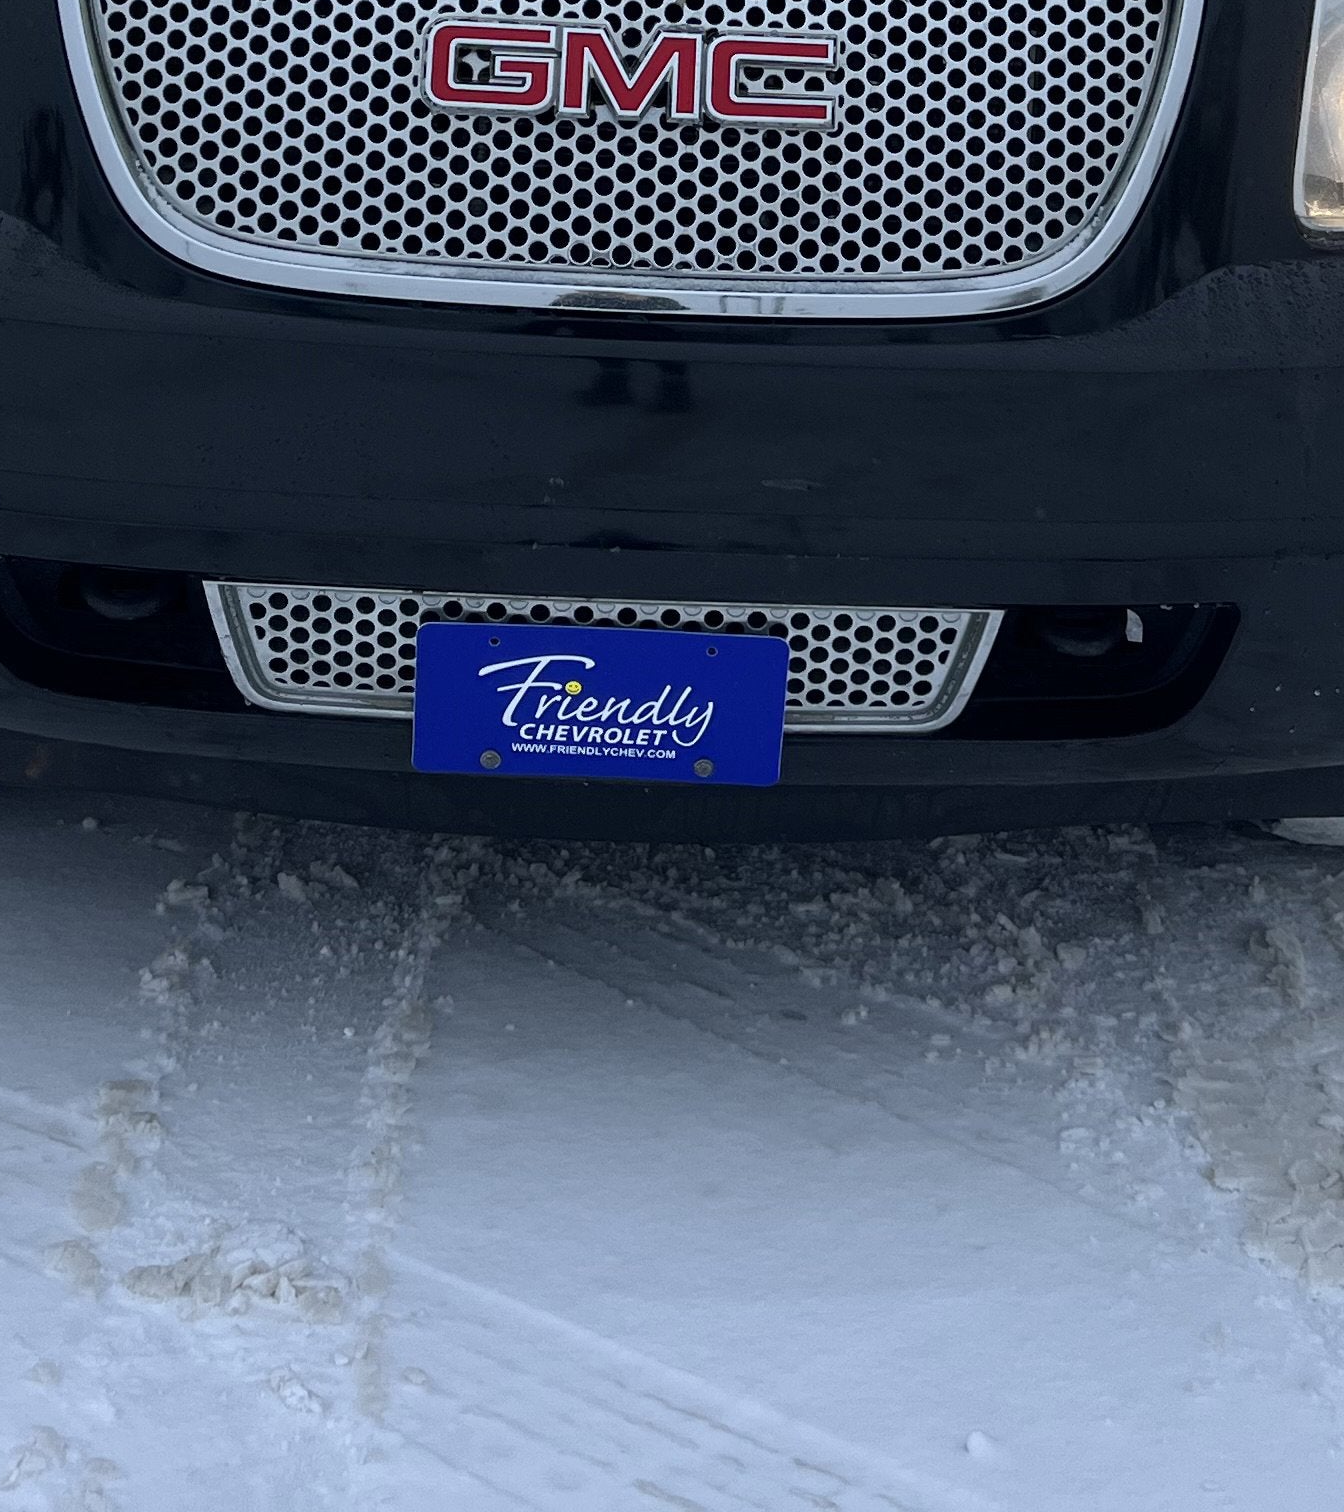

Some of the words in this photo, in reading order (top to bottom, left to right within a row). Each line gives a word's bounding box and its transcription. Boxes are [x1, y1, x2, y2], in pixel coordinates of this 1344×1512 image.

[422, 18, 837, 130] GMC
[478, 654, 715, 747] Friendly
[511, 742, 676, 759] WWW.FRIENDLYCHEV.COM
[519, 723, 668, 746] CHEVROLET
